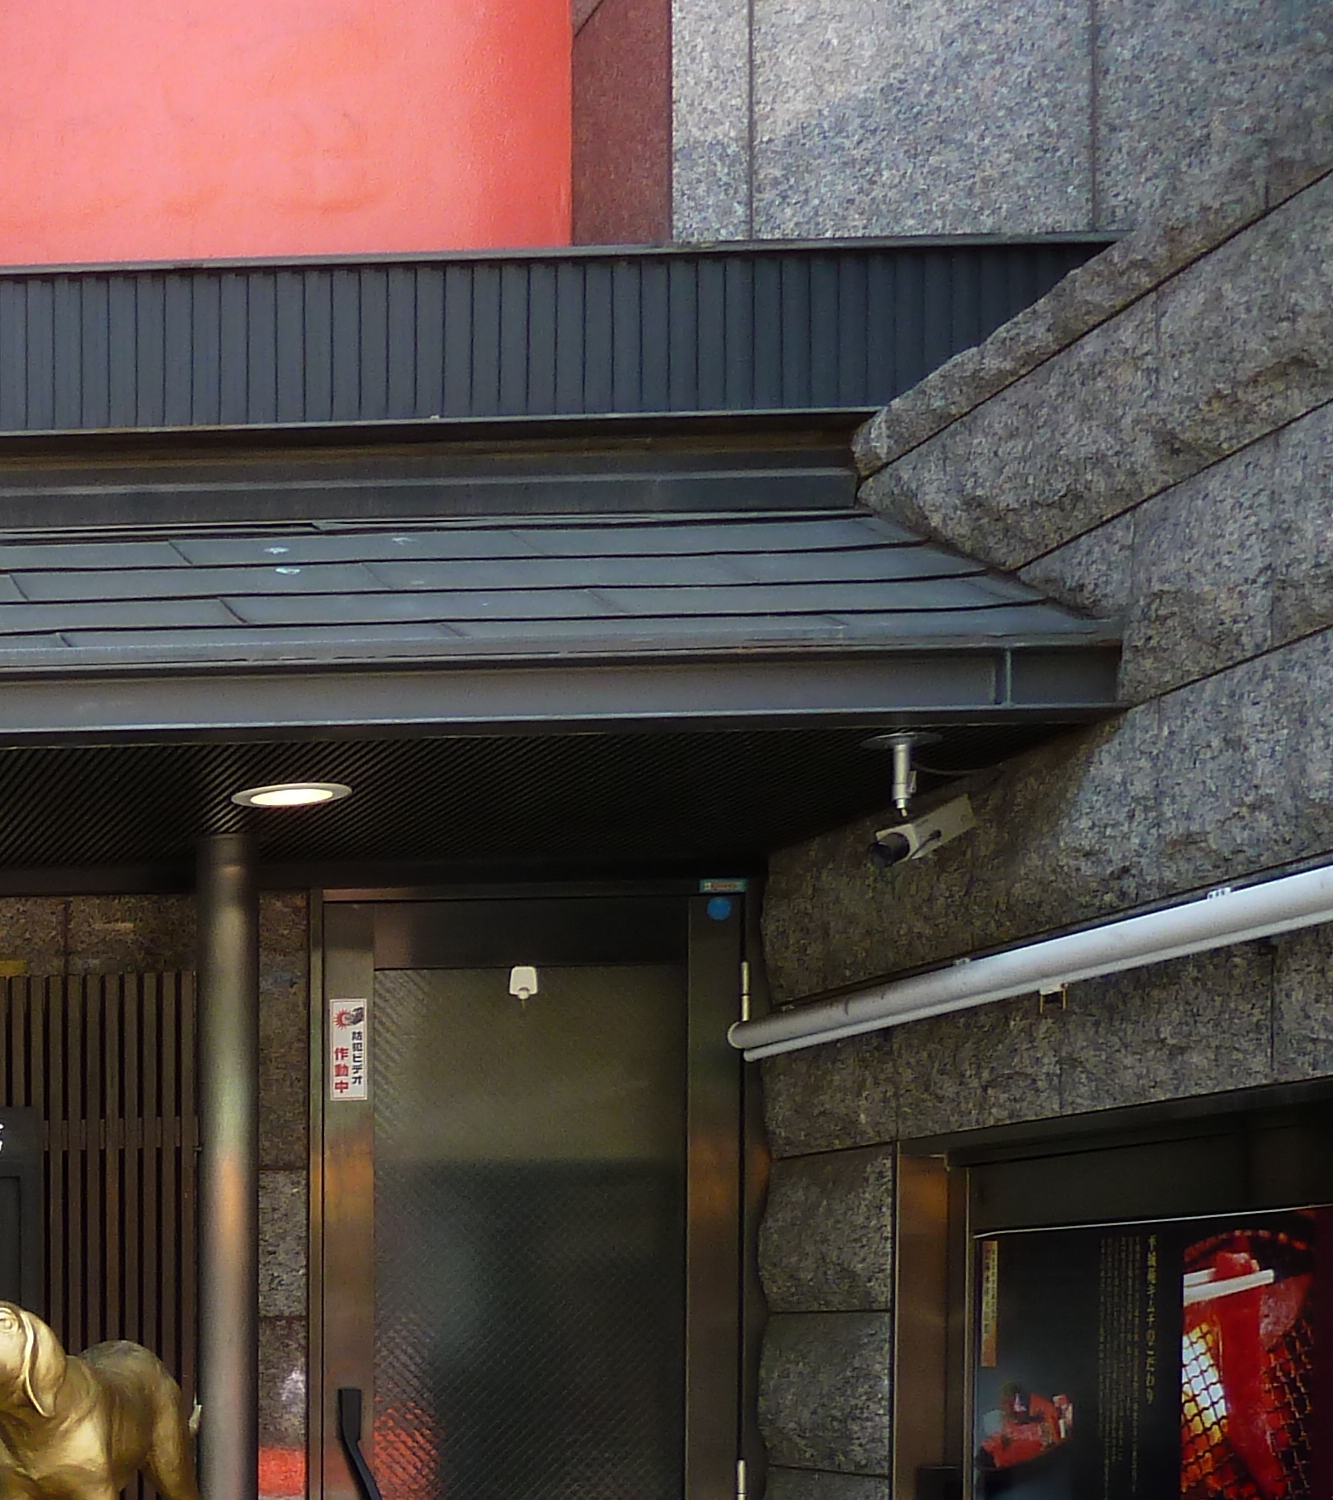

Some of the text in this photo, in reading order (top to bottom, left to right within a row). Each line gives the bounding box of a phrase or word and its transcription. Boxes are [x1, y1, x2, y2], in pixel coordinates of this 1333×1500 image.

[334, 1046, 350, 1094] 作動中
[351, 1030, 363, 1085] 防犯ビデオ
